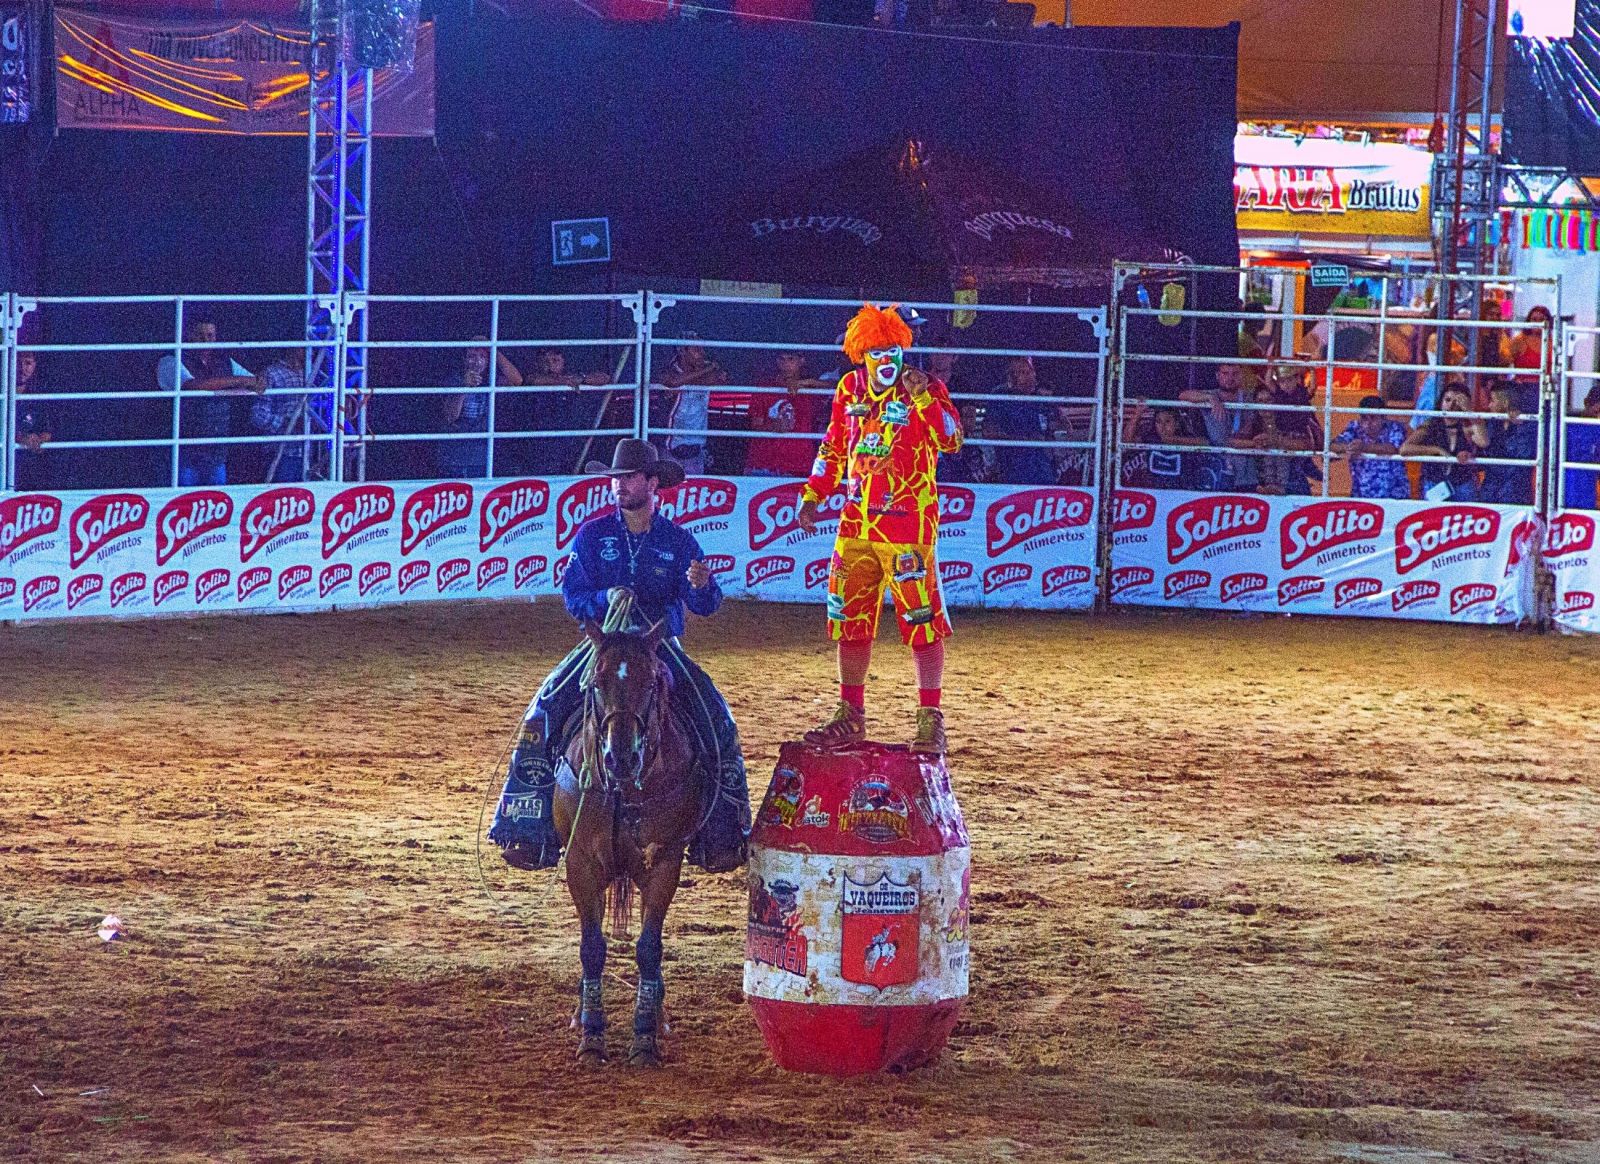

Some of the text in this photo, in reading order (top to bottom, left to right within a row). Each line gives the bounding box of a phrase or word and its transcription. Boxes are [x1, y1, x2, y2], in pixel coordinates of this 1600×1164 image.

[1349, 179, 1421, 210] Brutus
[1314, 266, 1346, 277] SAÍDA
[661, 486, 727, 520] olito
[1113, 498, 1147, 523] ito
[0, 503, 54, 546] olito
[74, 500, 142, 561] Solito
[160, 500, 227, 559] Solito
[241, 497, 309, 555] Solito
[325, 494, 390, 551] Solito
[403, 491, 465, 549] Solito
[481, 487, 544, 547] Solito
[991, 497, 1083, 550] Solito
[1172, 505, 1259, 556] Solito
[182, 533, 226, 560] Alimentos
[265, 531, 309, 556] Alimentos
[346, 527, 389, 553] Alimentos
[425, 524, 467, 549] Alimentos
[502, 521, 544, 546] Alimentos
[1023, 531, 1084, 554] Alimentos
[1114, 533, 1148, 546] entos
[1285, 510, 1375, 562] Solito
[1400, 512, 1491, 567] Solito
[9, 540, 55, 567] Alimentos
[97, 536, 142, 563] Alimentos
[1203, 537, 1262, 561] Alimentos
[1317, 543, 1375, 567] Alimentos
[1431, 549, 1491, 572] Alimentos
[400, 564, 428, 591] Solito
[438, 562, 468, 589] Solito
[478, 561, 506, 587] Solito
[516, 559, 545, 586] Solito
[708, 558, 731, 570] lito
[748, 559, 791, 585] Solito
[940, 565, 968, 579] olito
[69, 578, 99, 606] Solito
[112, 576, 142, 604] Solito
[155, 575, 186, 602] Solito
[198, 572, 227, 600] Solito
[239, 570, 269, 599] Solito
[280, 568, 309, 597] Solito
[320, 567, 350, 595] Solito
[360, 565, 388, 593] Solito
[986, 566, 1029, 591] Solito
[1045, 569, 1088, 594] Solito
[1166, 573, 1207, 597] Solito
[1222, 576, 1264, 600] Solito
[1280, 580, 1321, 604] Solito
[26, 580, 56, 608] Solito
[1336, 581, 1378, 607] Solito
[1395, 585, 1437, 610] Solito
[1452, 587, 1493, 612] Solito
[850, 890, 915, 908] VAQUEIROS
